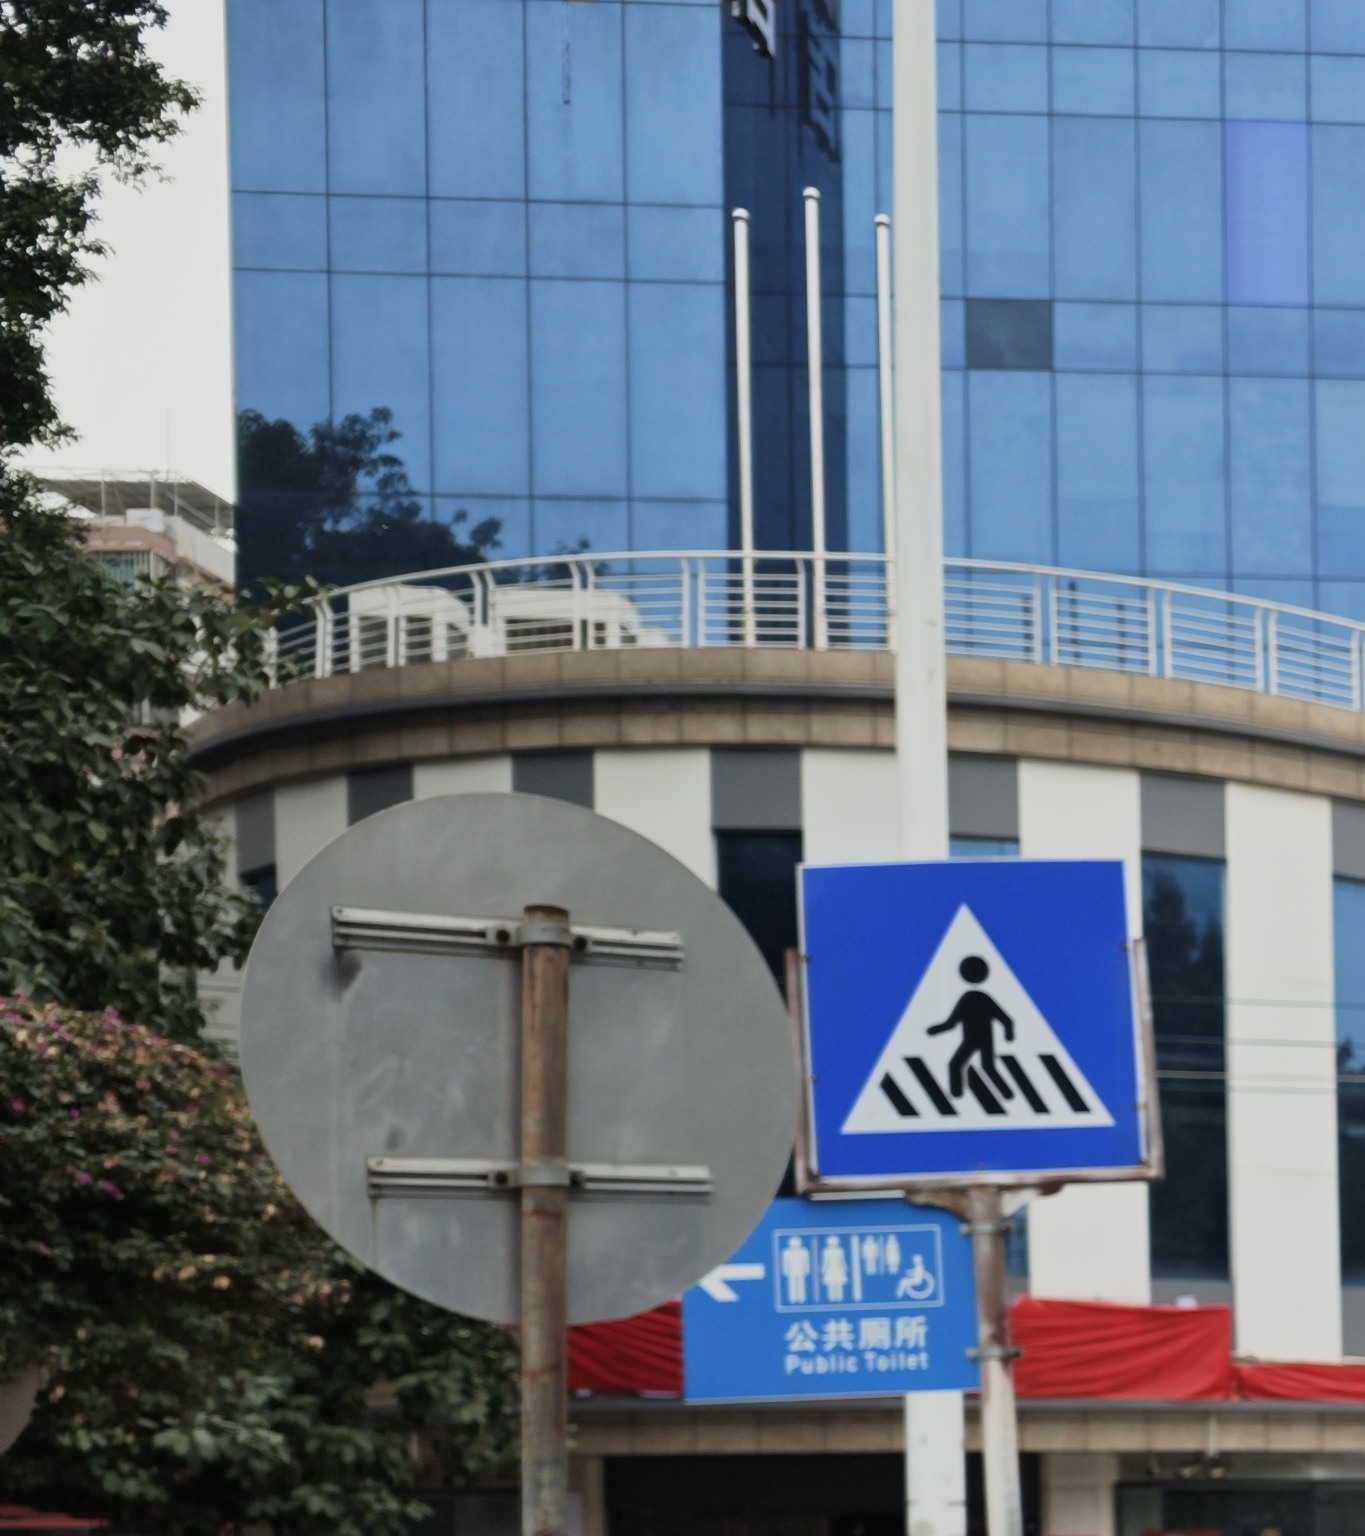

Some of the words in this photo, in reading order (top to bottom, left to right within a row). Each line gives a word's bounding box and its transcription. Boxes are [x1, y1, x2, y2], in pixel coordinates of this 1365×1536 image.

[784, 1315, 928, 1352] 公共厕所
[784, 1354, 858, 1375] Public
[864, 1351, 929, 1372] Toilet
